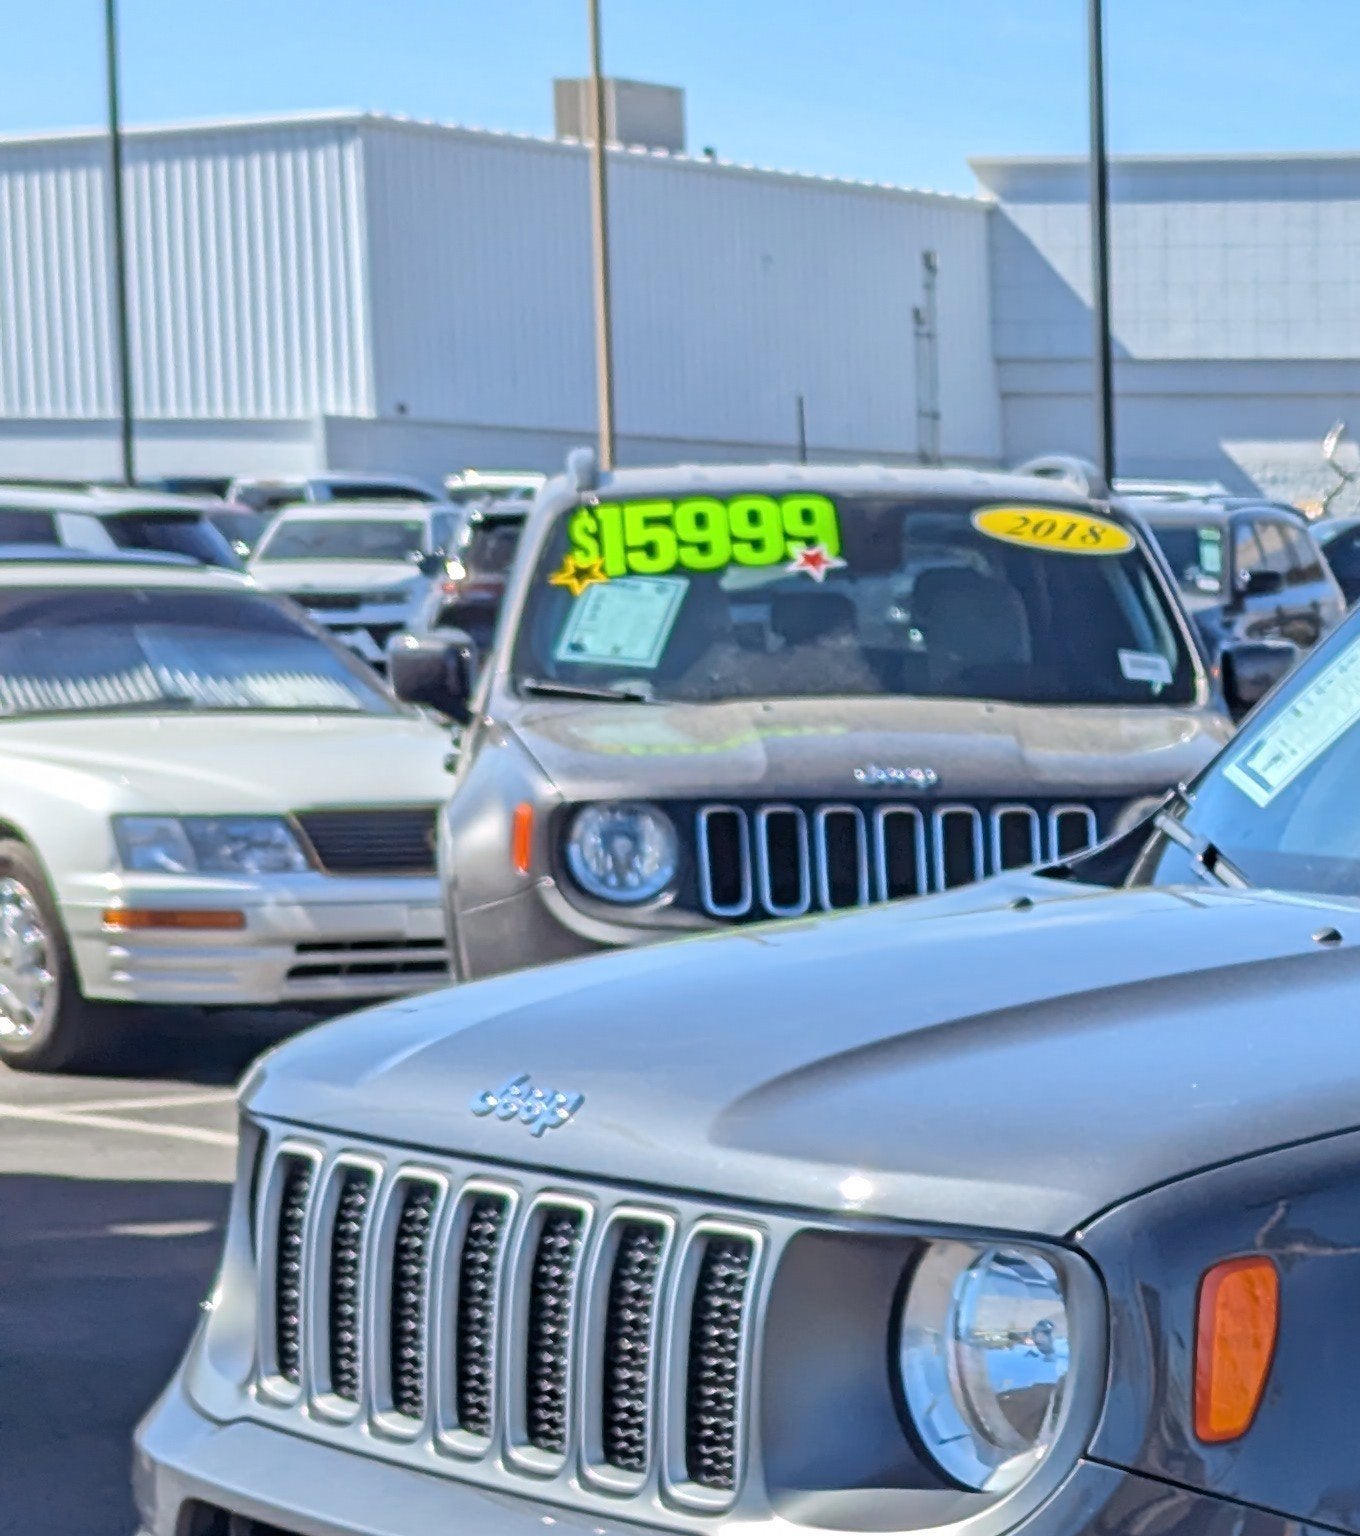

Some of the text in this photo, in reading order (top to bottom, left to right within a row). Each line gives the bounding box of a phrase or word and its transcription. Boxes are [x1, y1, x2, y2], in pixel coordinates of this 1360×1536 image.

[567, 490, 841, 577] $15999
[1005, 515, 1106, 546] 2018
[469, 1073, 586, 1138] Jeep
